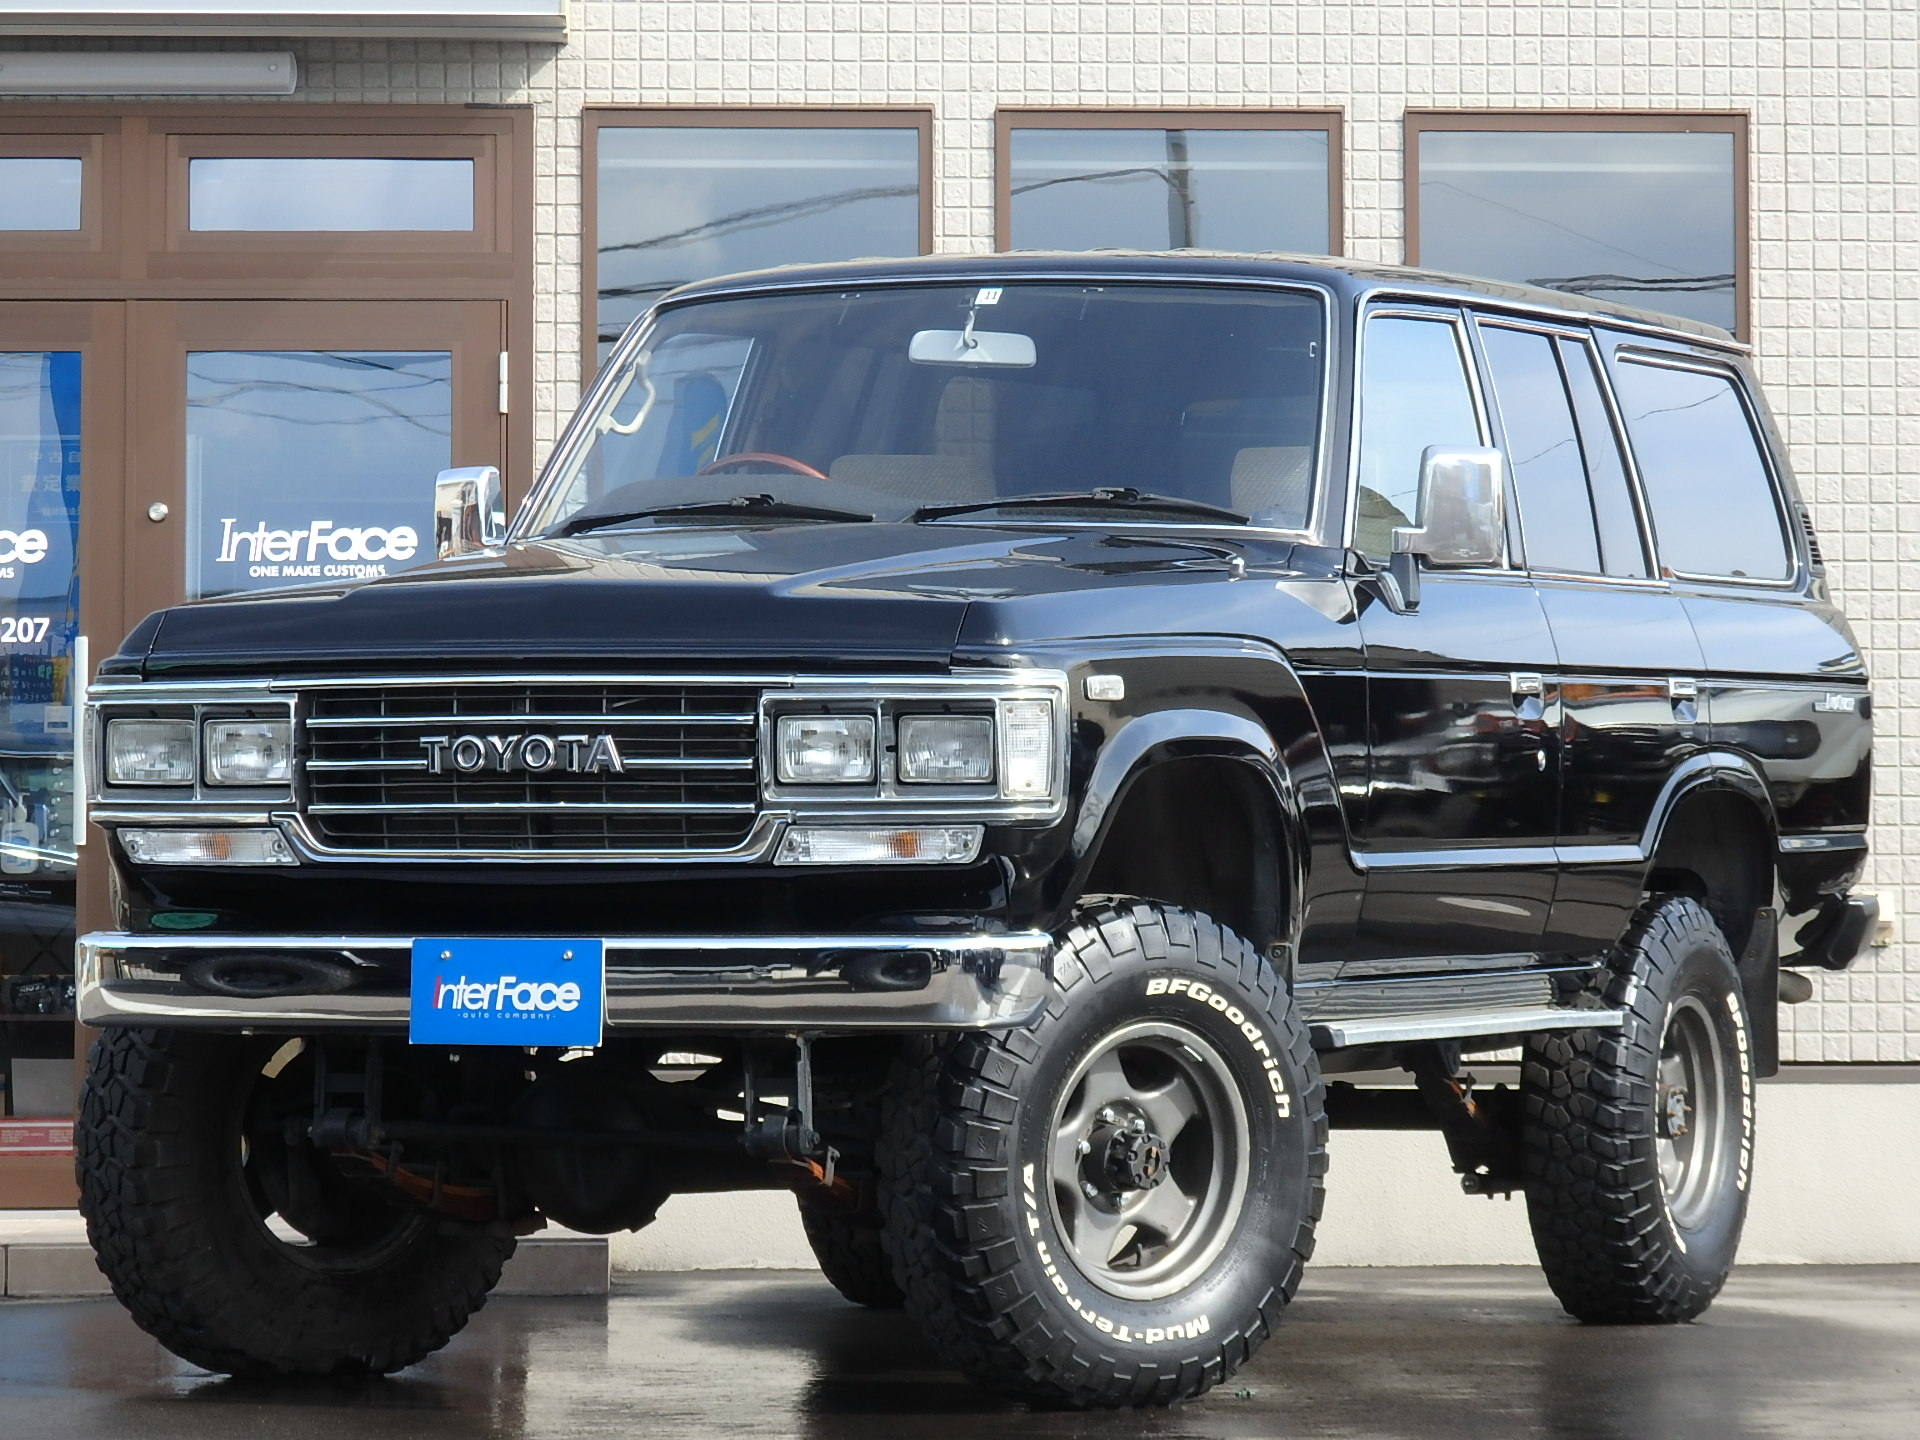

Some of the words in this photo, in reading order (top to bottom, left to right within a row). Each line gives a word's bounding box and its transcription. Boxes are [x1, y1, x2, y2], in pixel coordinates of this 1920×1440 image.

[216, 518, 419, 562] InterFace
[249, 564, 280, 577] ONE
[282, 564, 321, 577] MAKE
[323, 564, 386, 578] CUSTOMS
[0, 617, 50, 643] 207
[419, 734, 625, 774] TOYOTA
[432, 975, 581, 1012] InterFace
[1145, 977, 1291, 1118] BFGoodrich
[1022, 1163, 1040, 1237] T/A
[1037, 1241, 1210, 1345] Mud-Terrain
